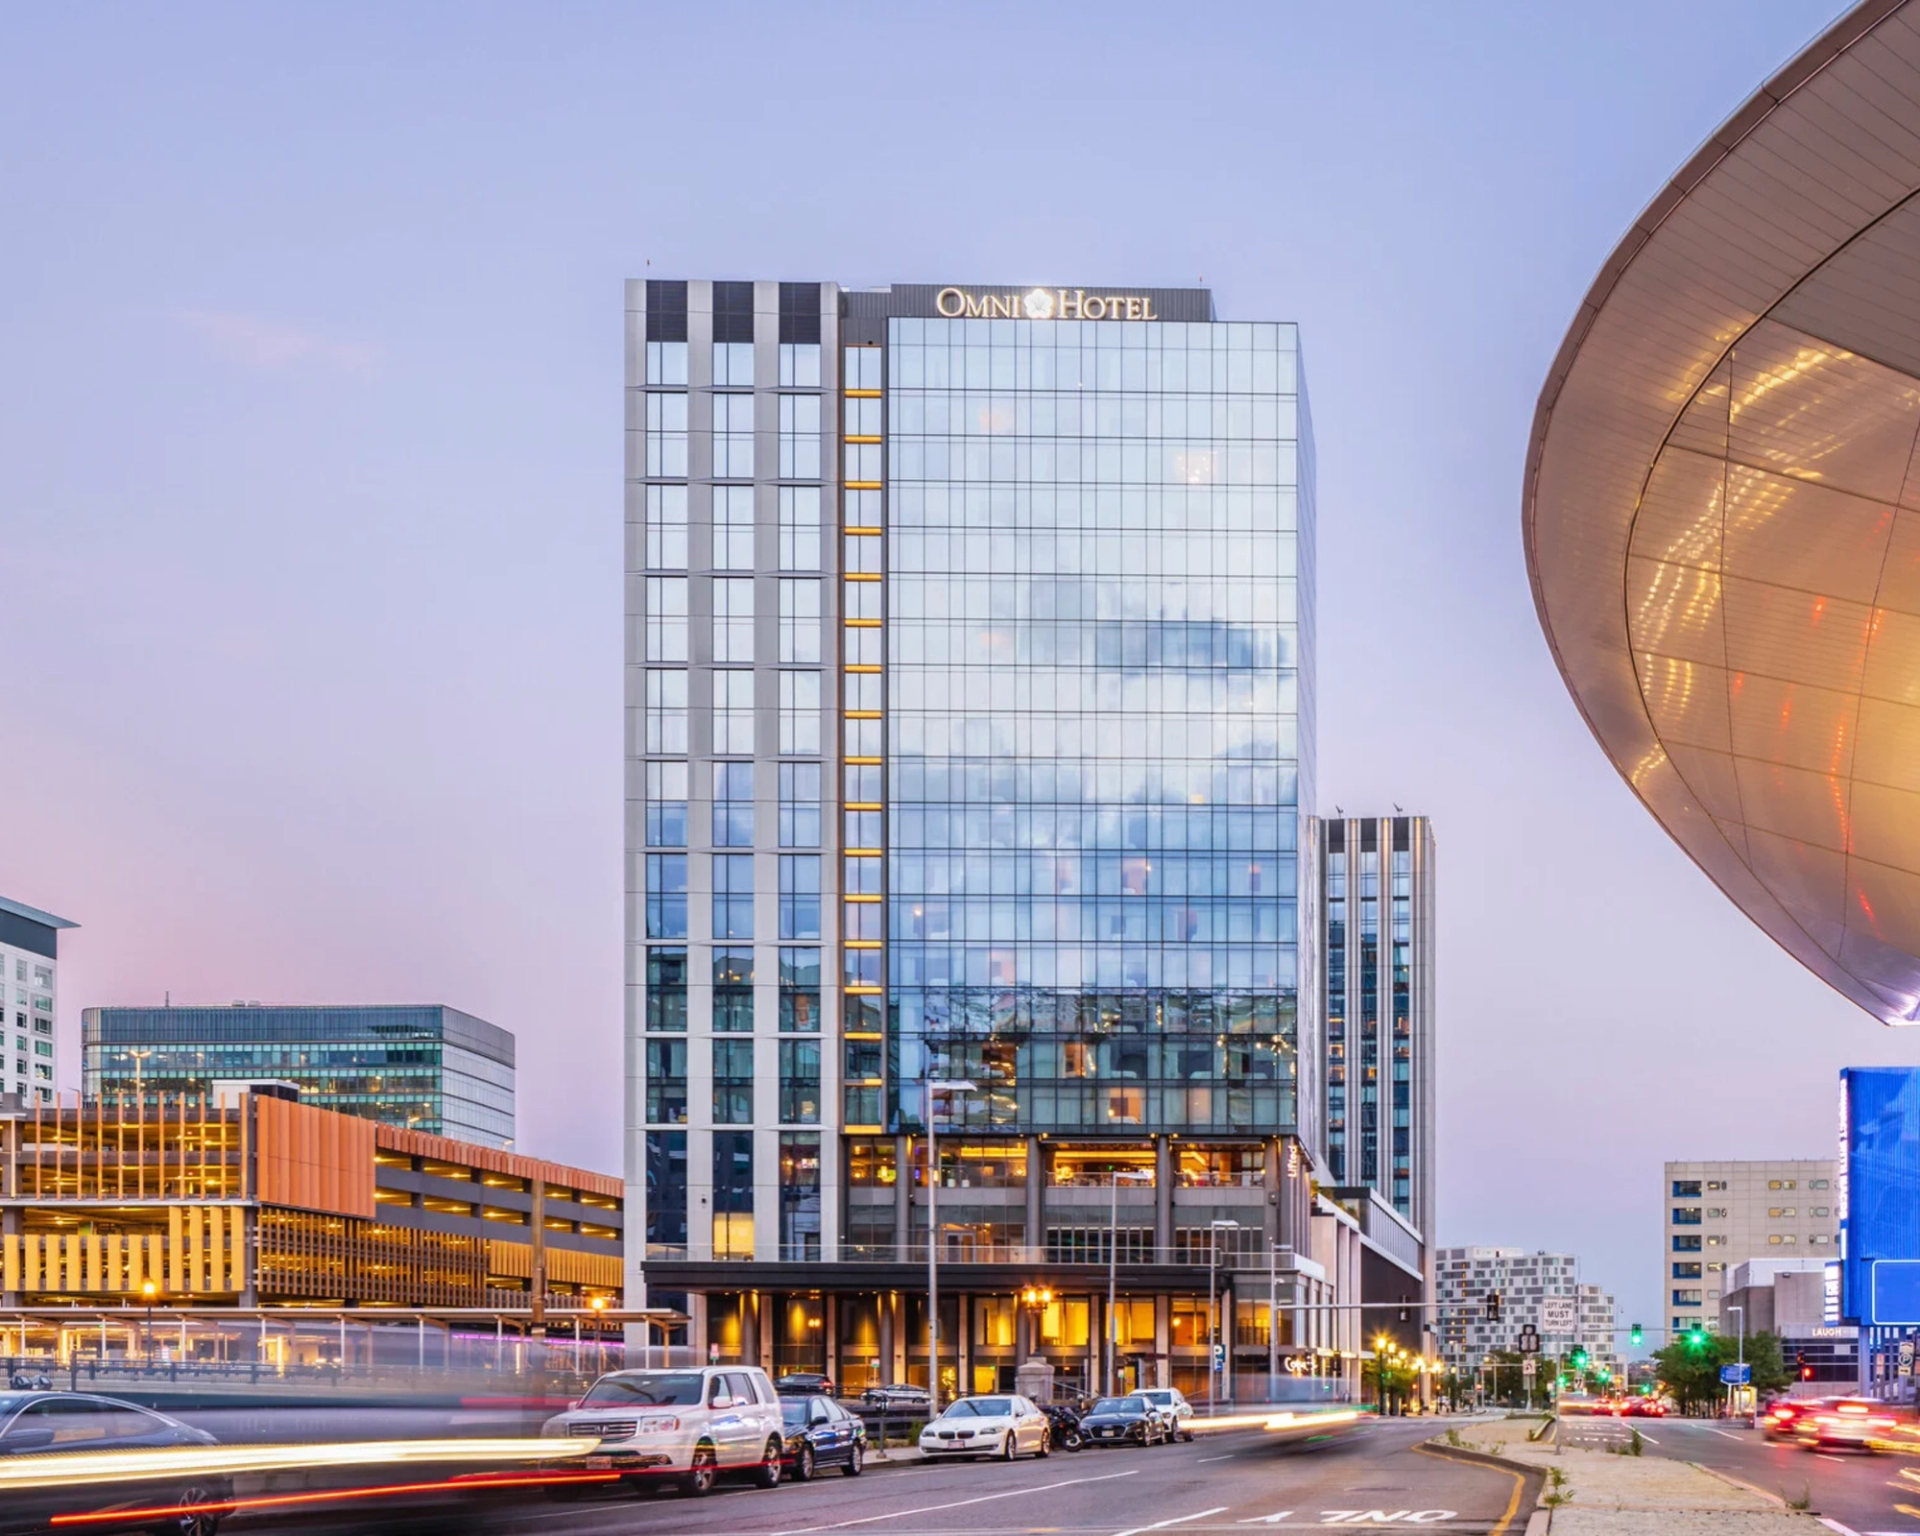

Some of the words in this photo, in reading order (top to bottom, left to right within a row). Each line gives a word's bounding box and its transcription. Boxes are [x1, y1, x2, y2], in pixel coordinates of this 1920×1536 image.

[1057, 289, 1158, 321] HOTEL
[1547, 1310, 1569, 1318] MUST
[1812, 1327, 1842, 1337] LAUGH
